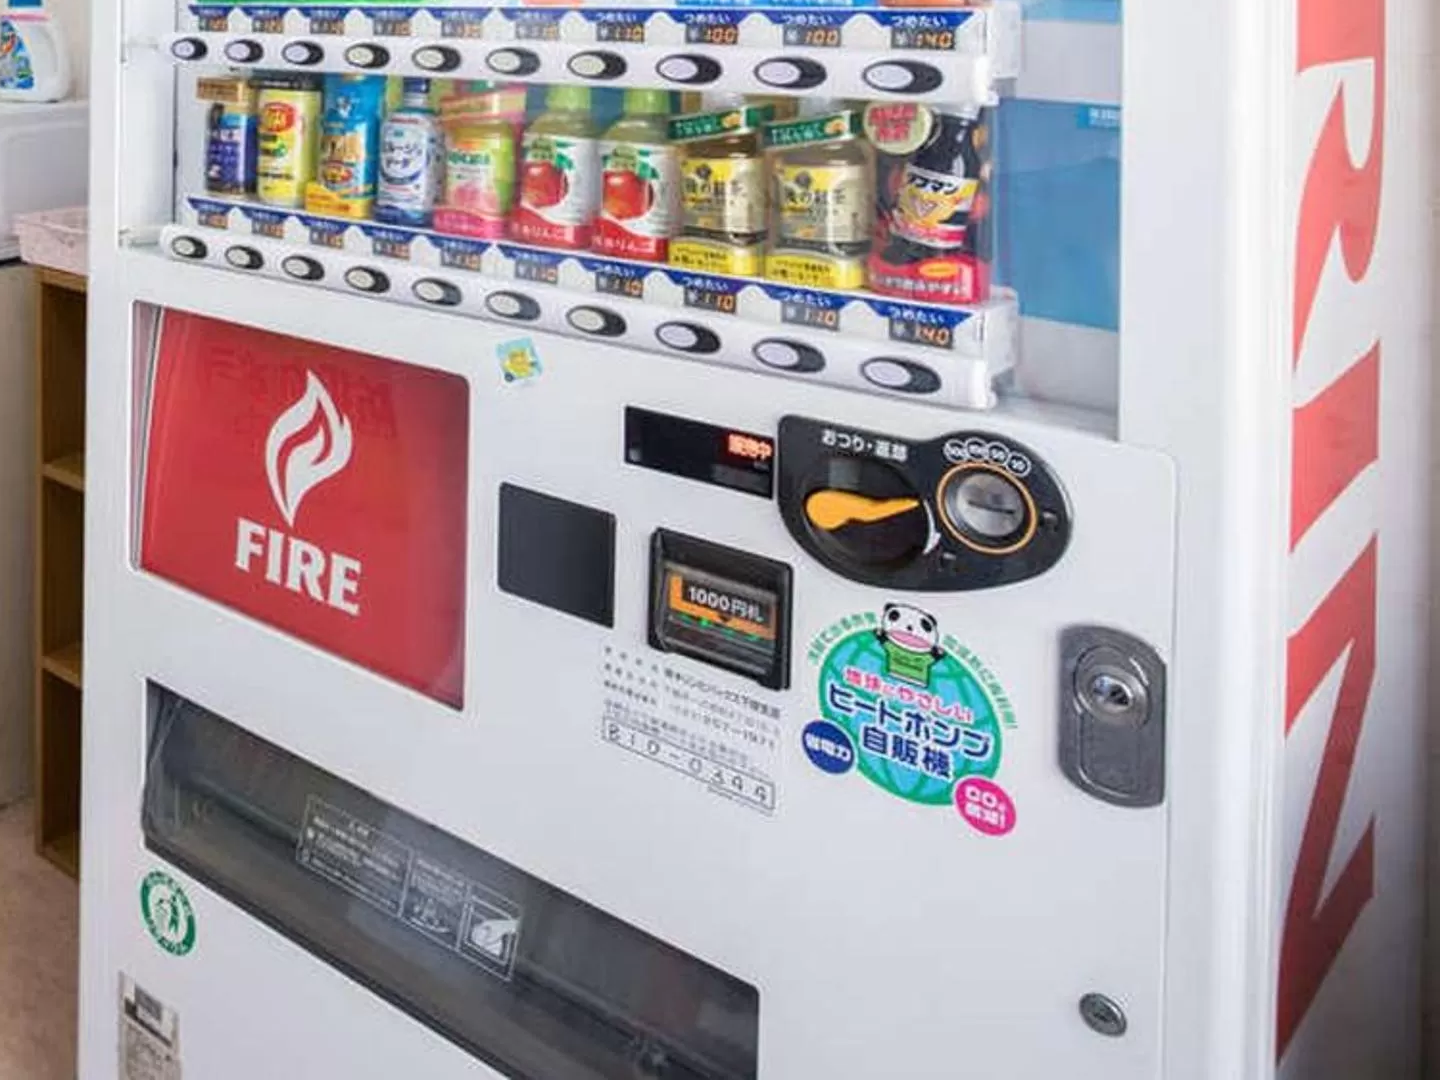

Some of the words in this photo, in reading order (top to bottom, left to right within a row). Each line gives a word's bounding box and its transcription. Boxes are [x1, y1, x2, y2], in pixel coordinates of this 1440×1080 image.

[596, 11, 637, 23] つめたい
[683, 12, 730, 24] つめたい
[782, 14, 833, 26] つめたい
[891, 14, 947, 27] つめたい
[681, 275, 728, 291] つめたい
[782, 290, 833, 307] つめたい
[888, 305, 946, 325] つめたい
[234, 517, 362, 617] FIRE
[828, 682, 992, 760] ヒートポンプ
[861, 725, 953, 779] 自販機
